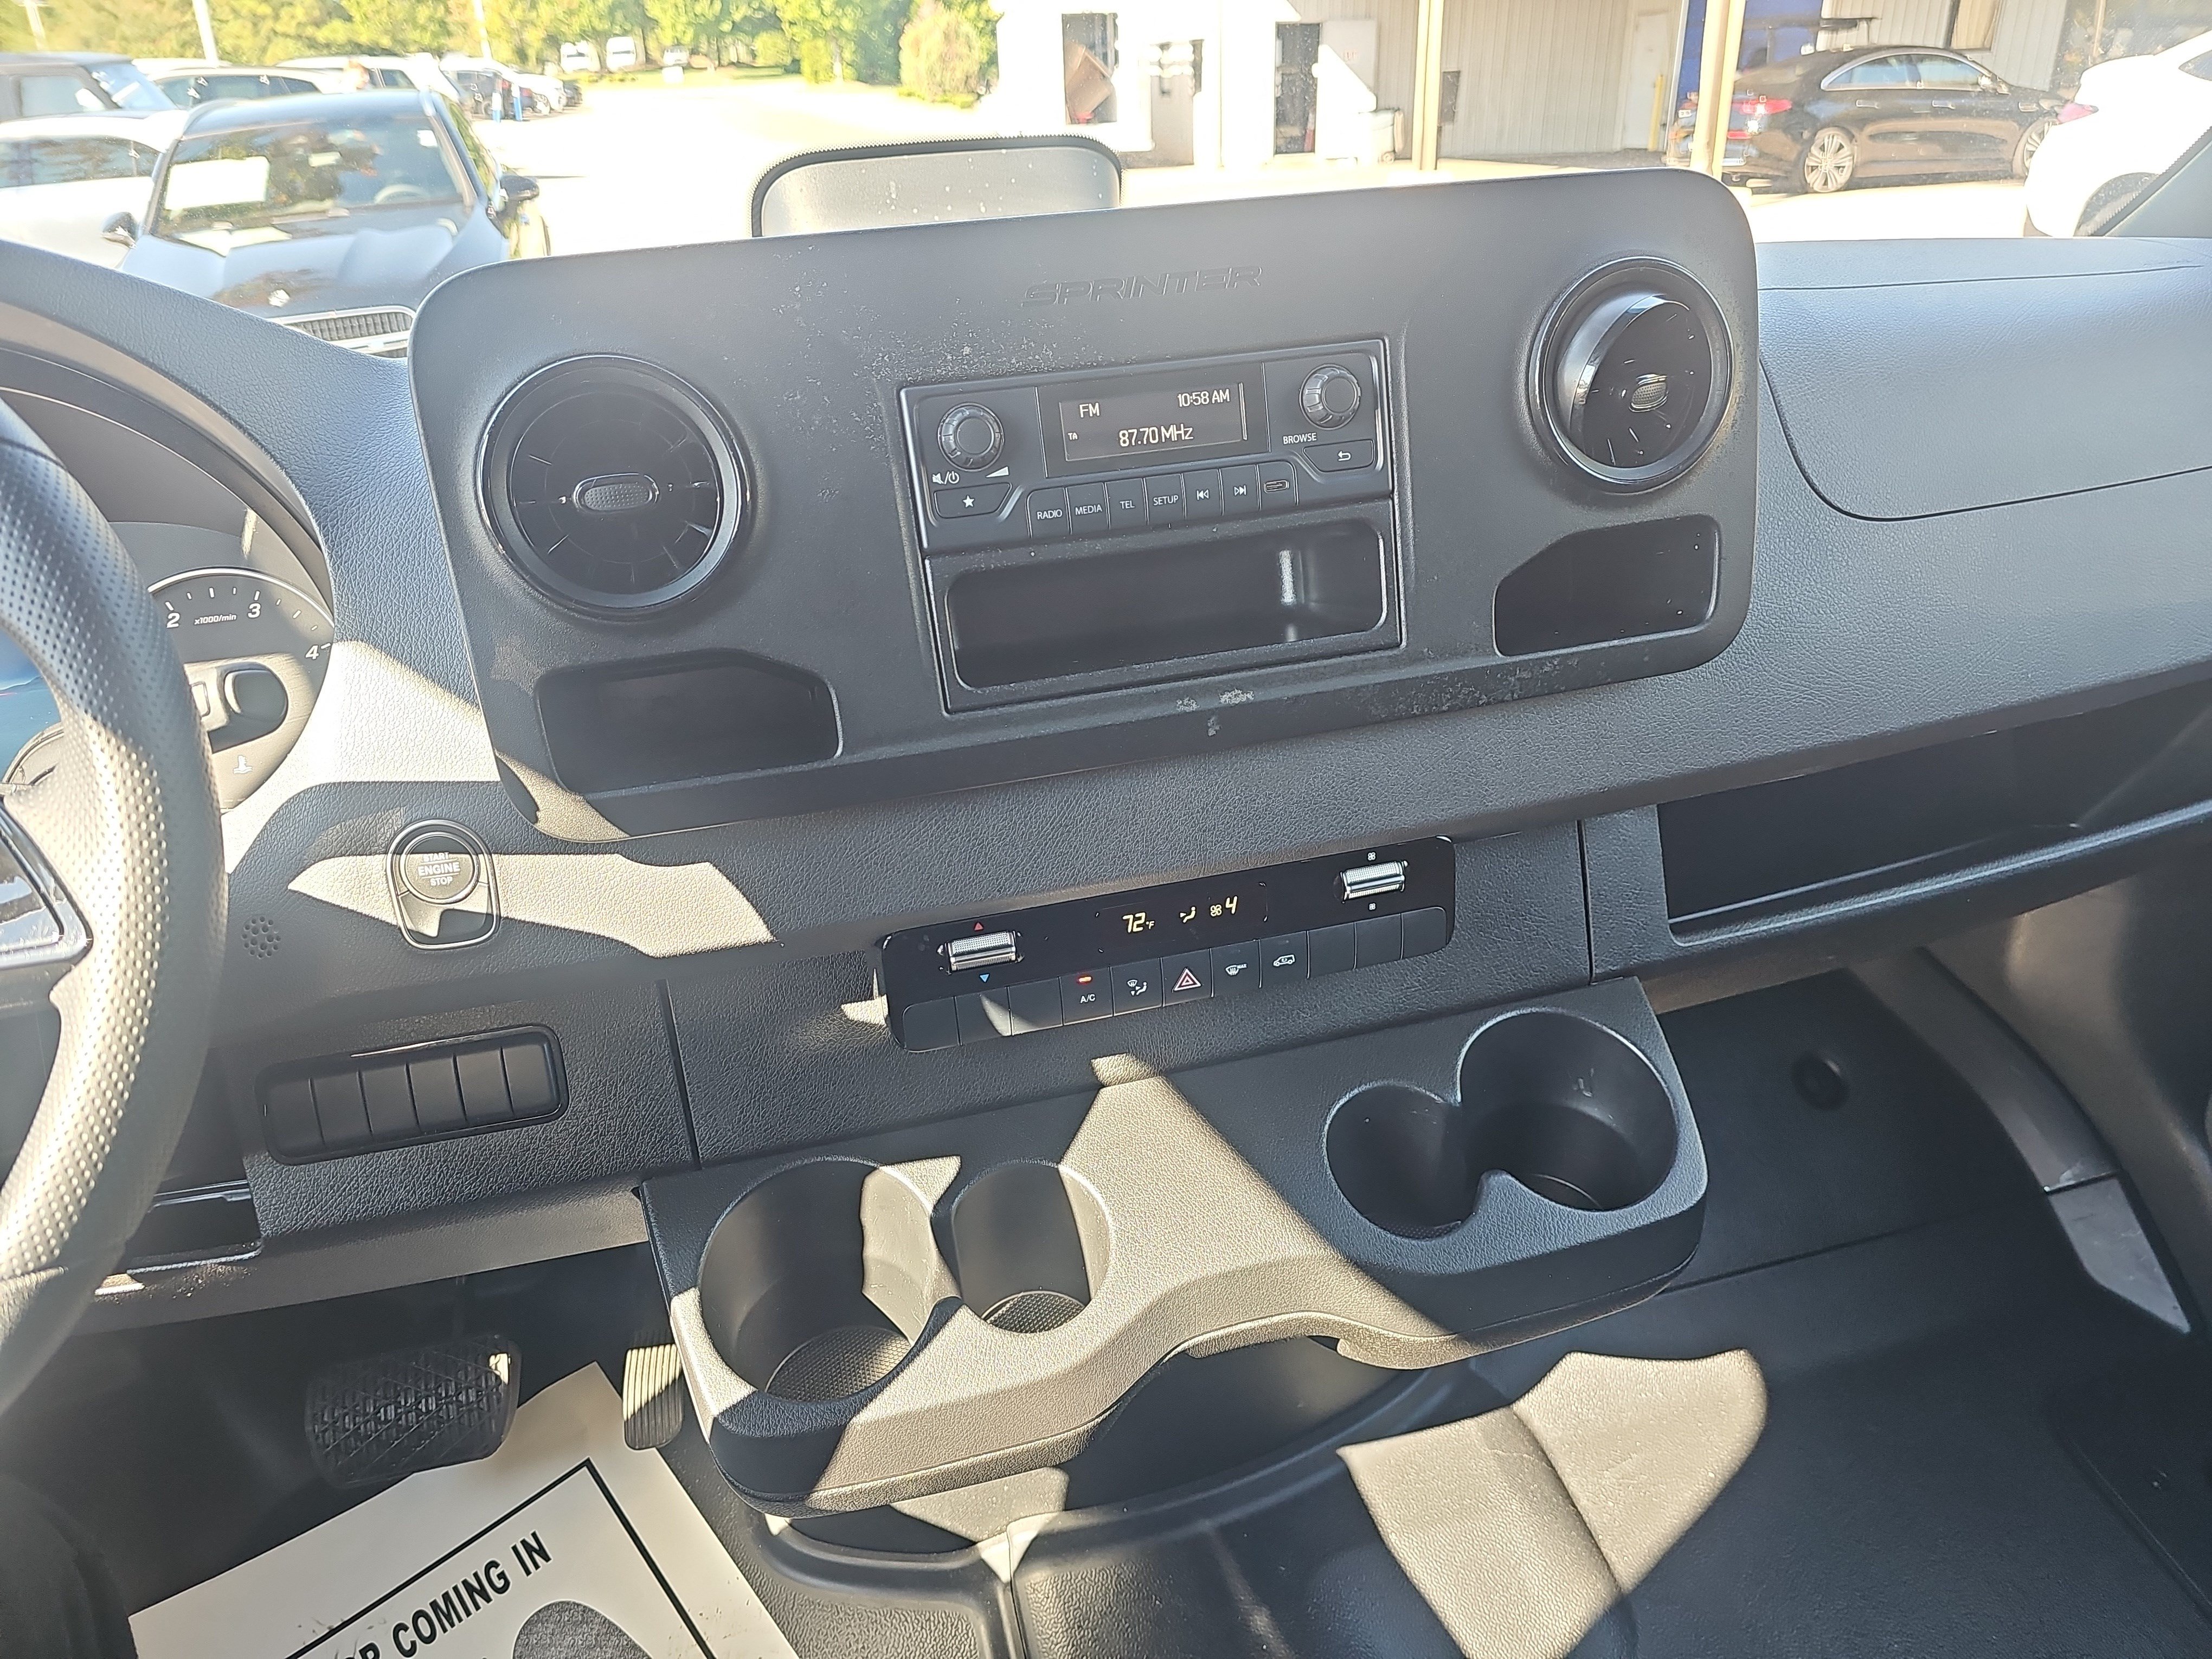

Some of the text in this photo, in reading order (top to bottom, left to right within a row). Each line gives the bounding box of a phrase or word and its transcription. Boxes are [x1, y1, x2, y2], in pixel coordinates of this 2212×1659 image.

[1020, 266, 1262, 307] SPRINTER
[1177, 388, 1230, 407] 10:58 AM
[1079, 402, 1100, 418] FM
[1068, 432, 1078, 440] TA
[1119, 423, 1194, 447] 87.70 MHz
[1283, 432, 1317, 445] BROWSE
[1120, 500, 1135, 510] TEL
[1153, 494, 1179, 506] SETUP
[1037, 509, 1063, 520] RADIO
[1075, 504, 1103, 516] MEDIA
[248, 602, 261, 619] 3
[166, 612, 180, 628] 2
[194, 613, 237, 626] x1000/min
[305, 645, 320, 660] 4
[422, 852, 450, 863] START
[417, 861, 461, 877] ENGINE
[430, 876, 453, 886] STOP
[1225, 895, 1238, 915] 4
[1080, 993, 1096, 1004] A/C
[392, 1529, 552, 1659] COMING IN
